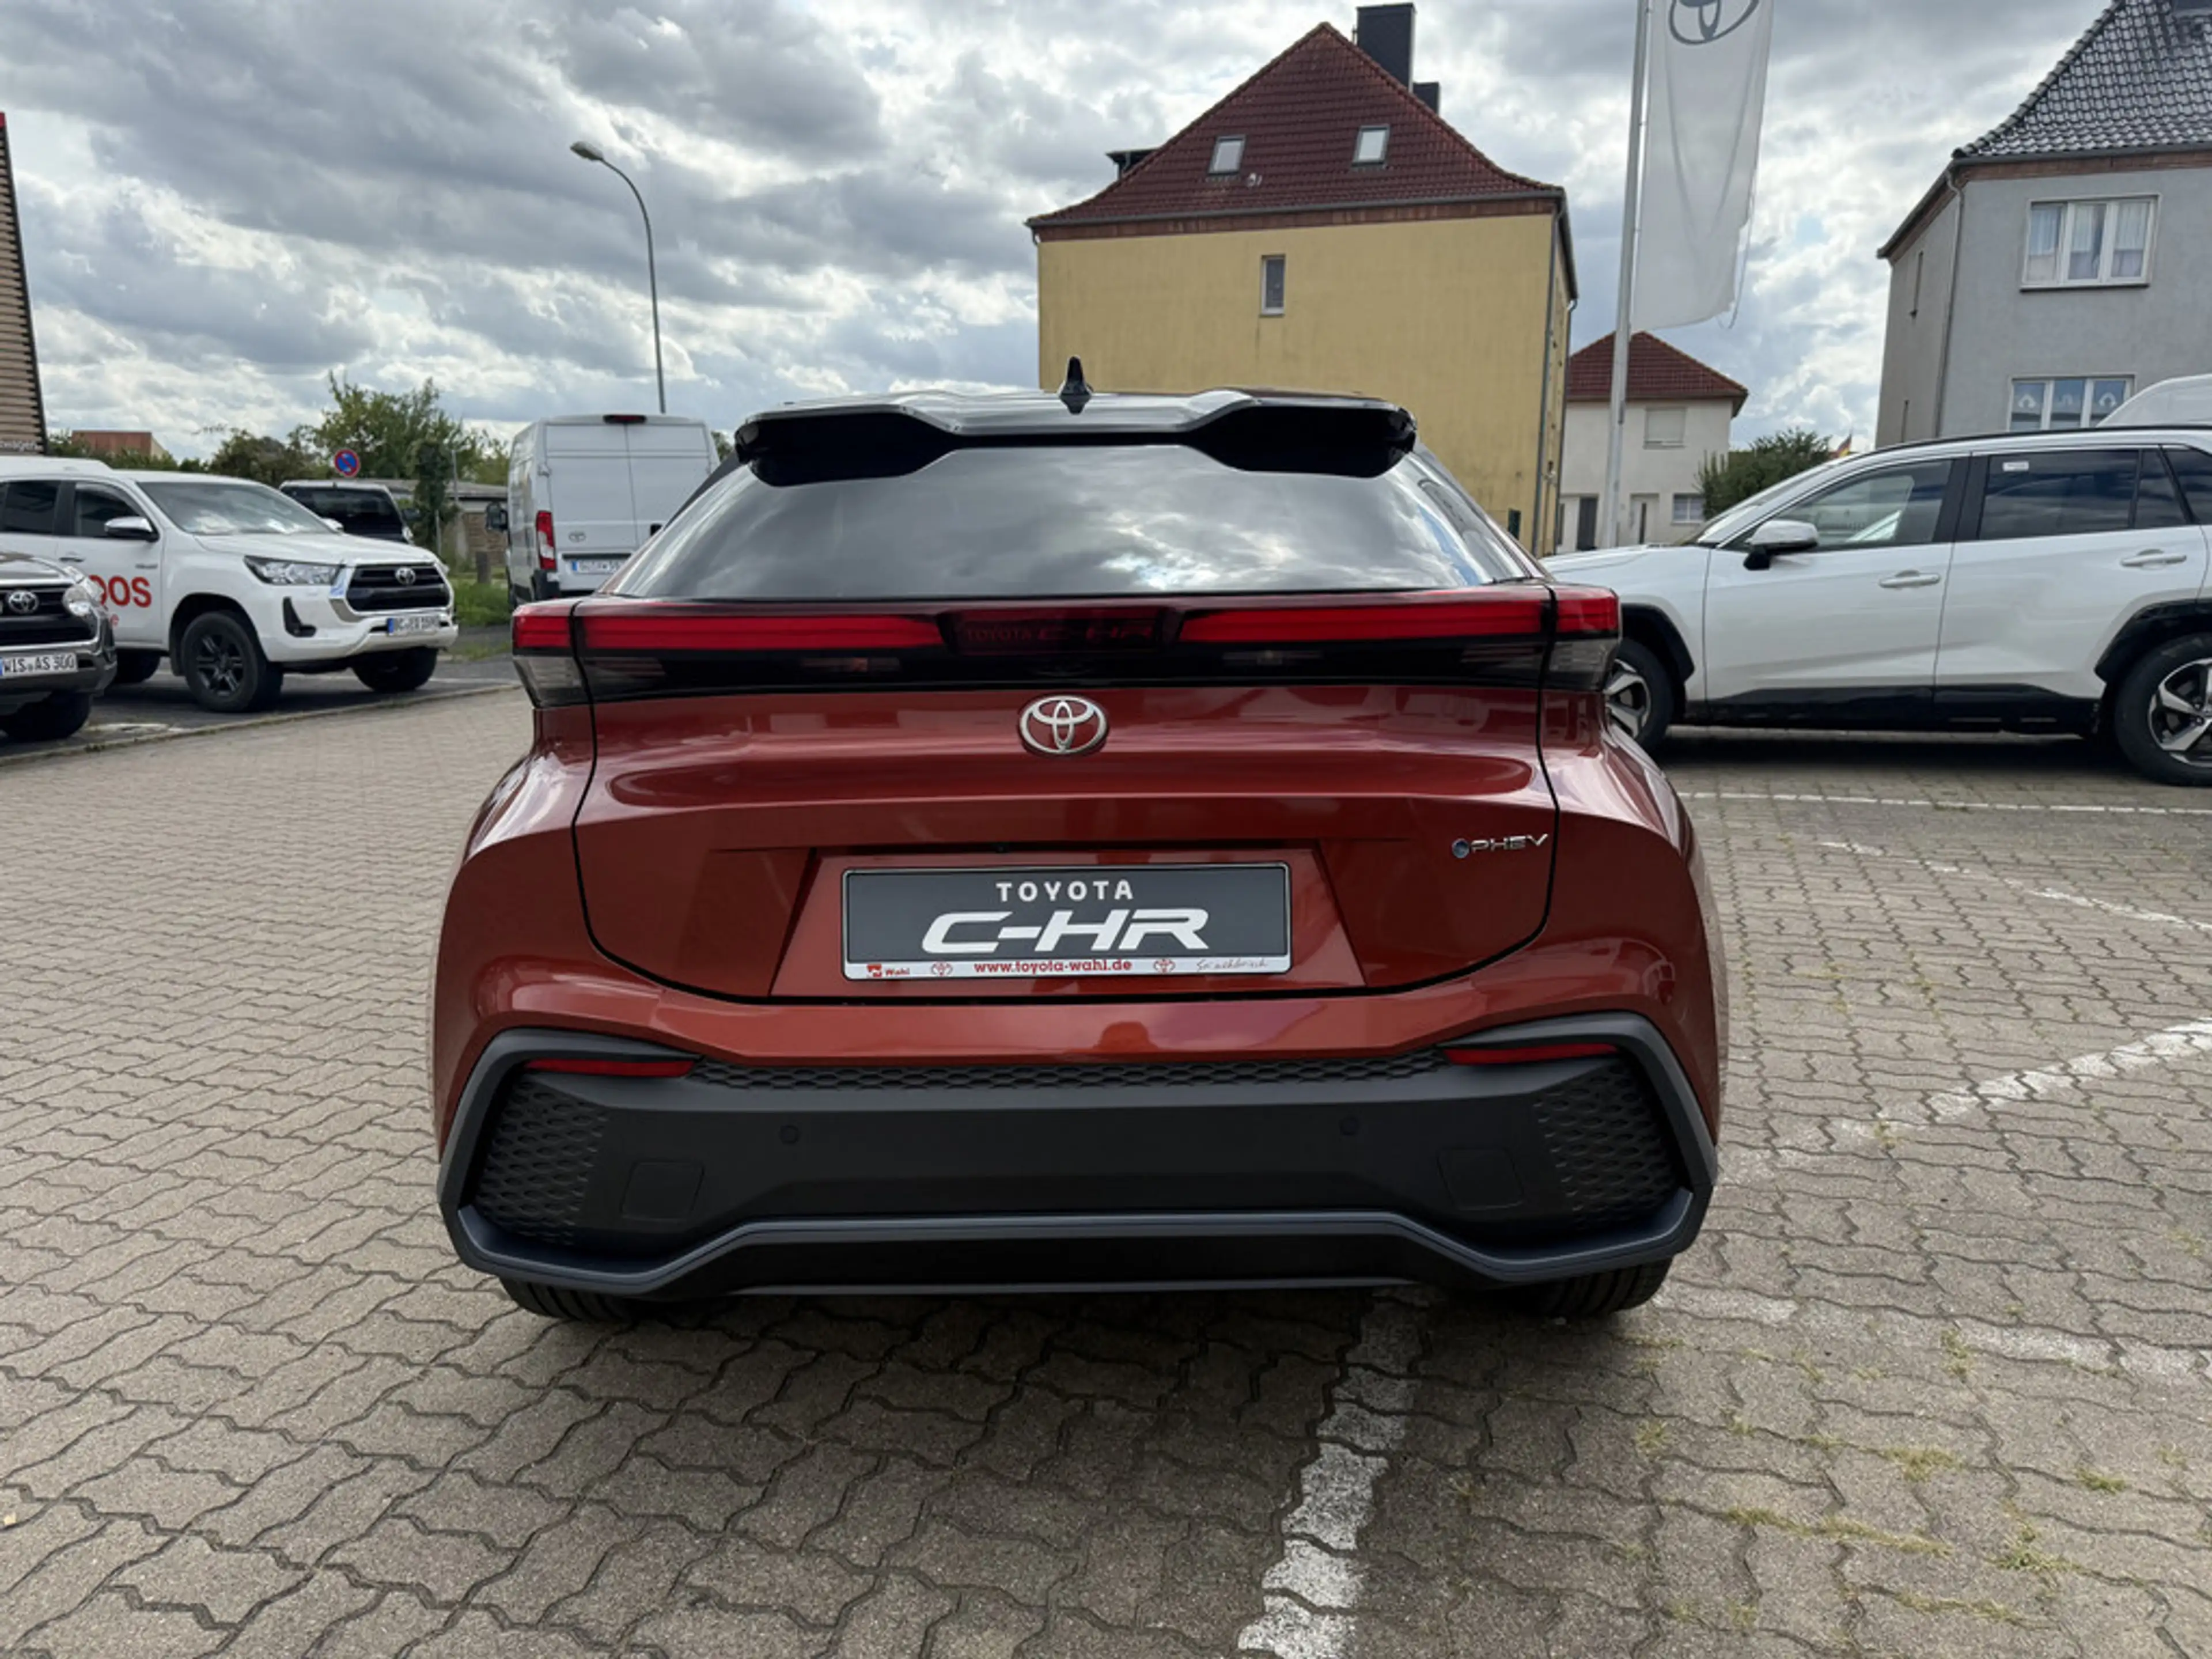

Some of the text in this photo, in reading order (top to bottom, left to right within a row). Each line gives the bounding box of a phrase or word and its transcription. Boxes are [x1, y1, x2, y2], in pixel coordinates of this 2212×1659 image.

[996, 880, 1134, 902] TOYOTA
[922, 908, 1209, 953] C-HR
[974, 959, 1132, 975] www.toyota-wahl.de
